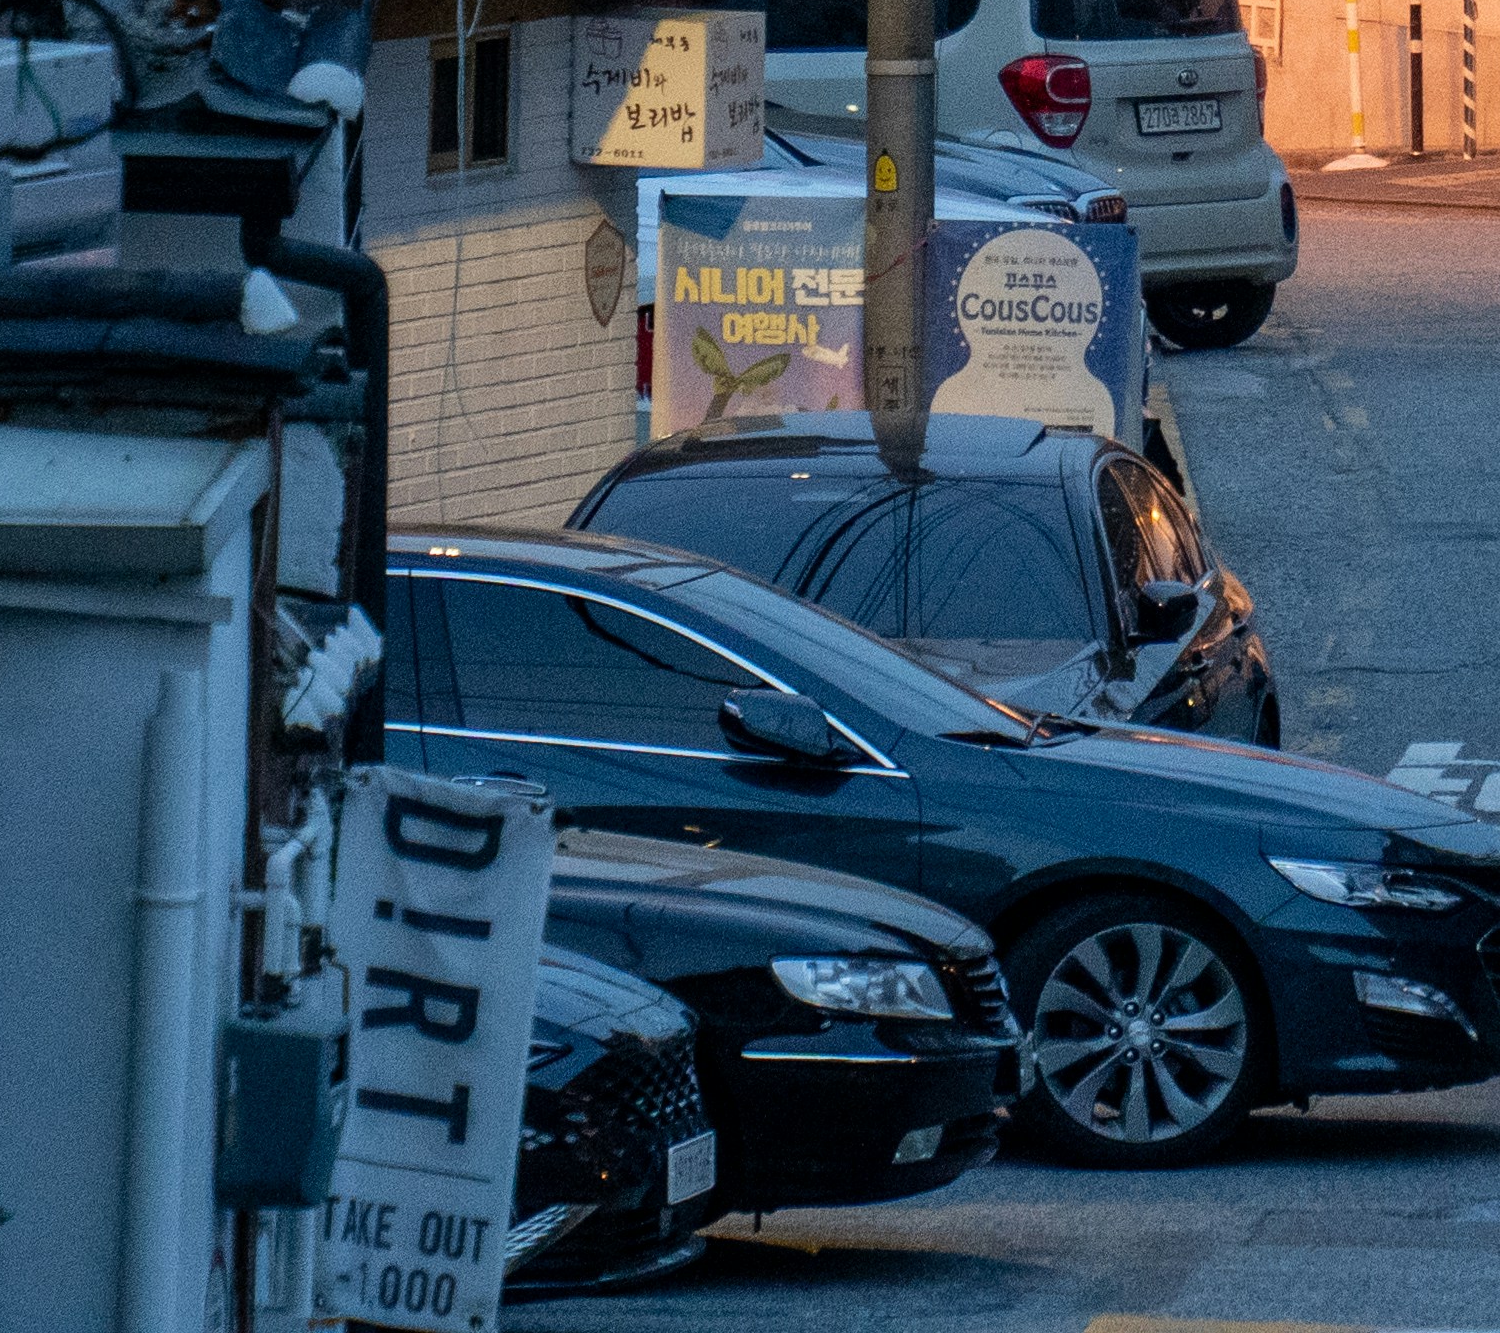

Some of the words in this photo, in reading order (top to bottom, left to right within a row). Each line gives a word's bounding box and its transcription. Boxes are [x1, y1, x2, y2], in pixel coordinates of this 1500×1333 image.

[582, 62, 668, 97] 수제비와
[626, 102, 697, 143] 보리밥
[675, 266, 784, 306] 시니어
[792, 268, 865, 306] 전문
[960, 292, 1099, 325] CousCous
[722, 312, 821, 347] 여행사
[324, 1194, 397, 1251] TAKE
[419, 1210, 490, 1265] OUT
